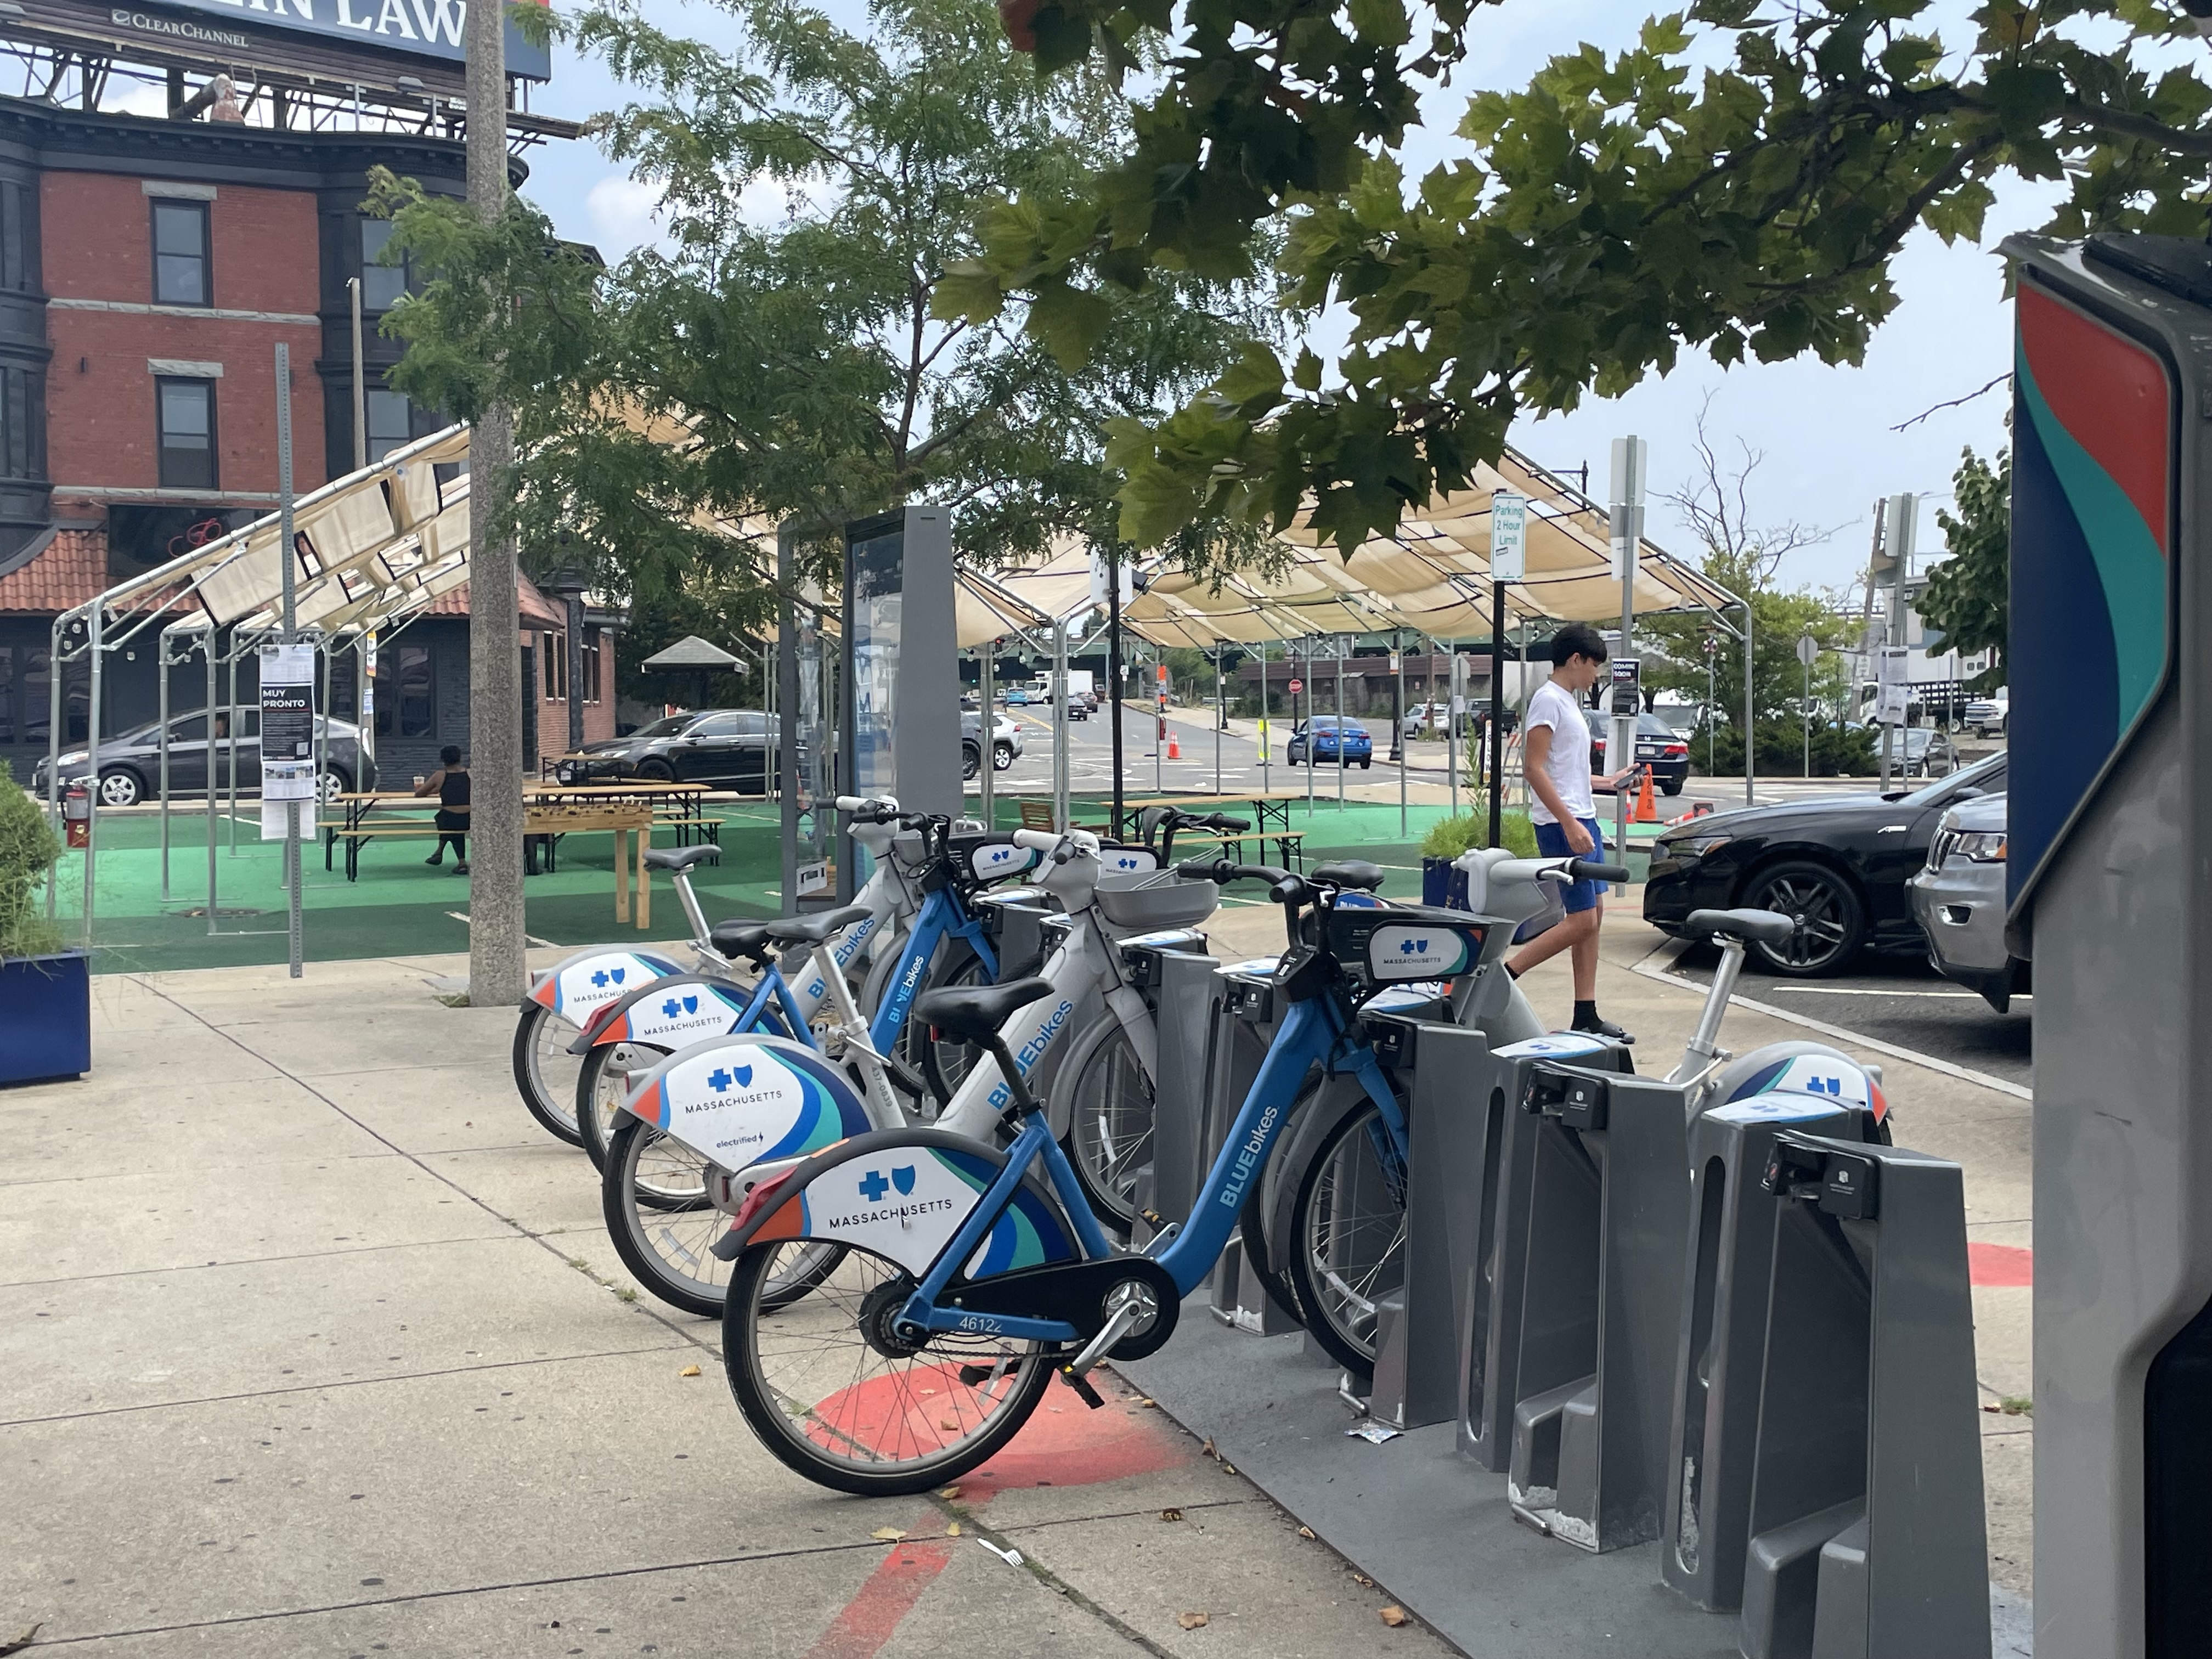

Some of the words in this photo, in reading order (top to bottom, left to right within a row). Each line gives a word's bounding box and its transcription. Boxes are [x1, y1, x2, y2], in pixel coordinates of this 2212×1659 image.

[337, 0, 466, 47] LAW
[1495, 505, 1522, 518] Parking
[1497, 520, 1502, 531] 2
[1503, 520, 1521, 531] Hour
[1499, 534, 1517, 545] Limit
[263, 689, 286, 698] MUY
[263, 699, 306, 708] PRONTO
[808, 918, 876, 1000] BLEbikes
[1383, 957, 1441, 965] MASSACHUSETTS
[644, 1016, 722, 1036] MASSACHUSETTS
[685, 1090, 783, 1114] MASSACHUSETTS
[716, 1135, 757, 1148] electrified
[1219, 1105, 1278, 1208] BLUEbikes
[829, 1199, 952, 1229] MASSACHUSETTS
